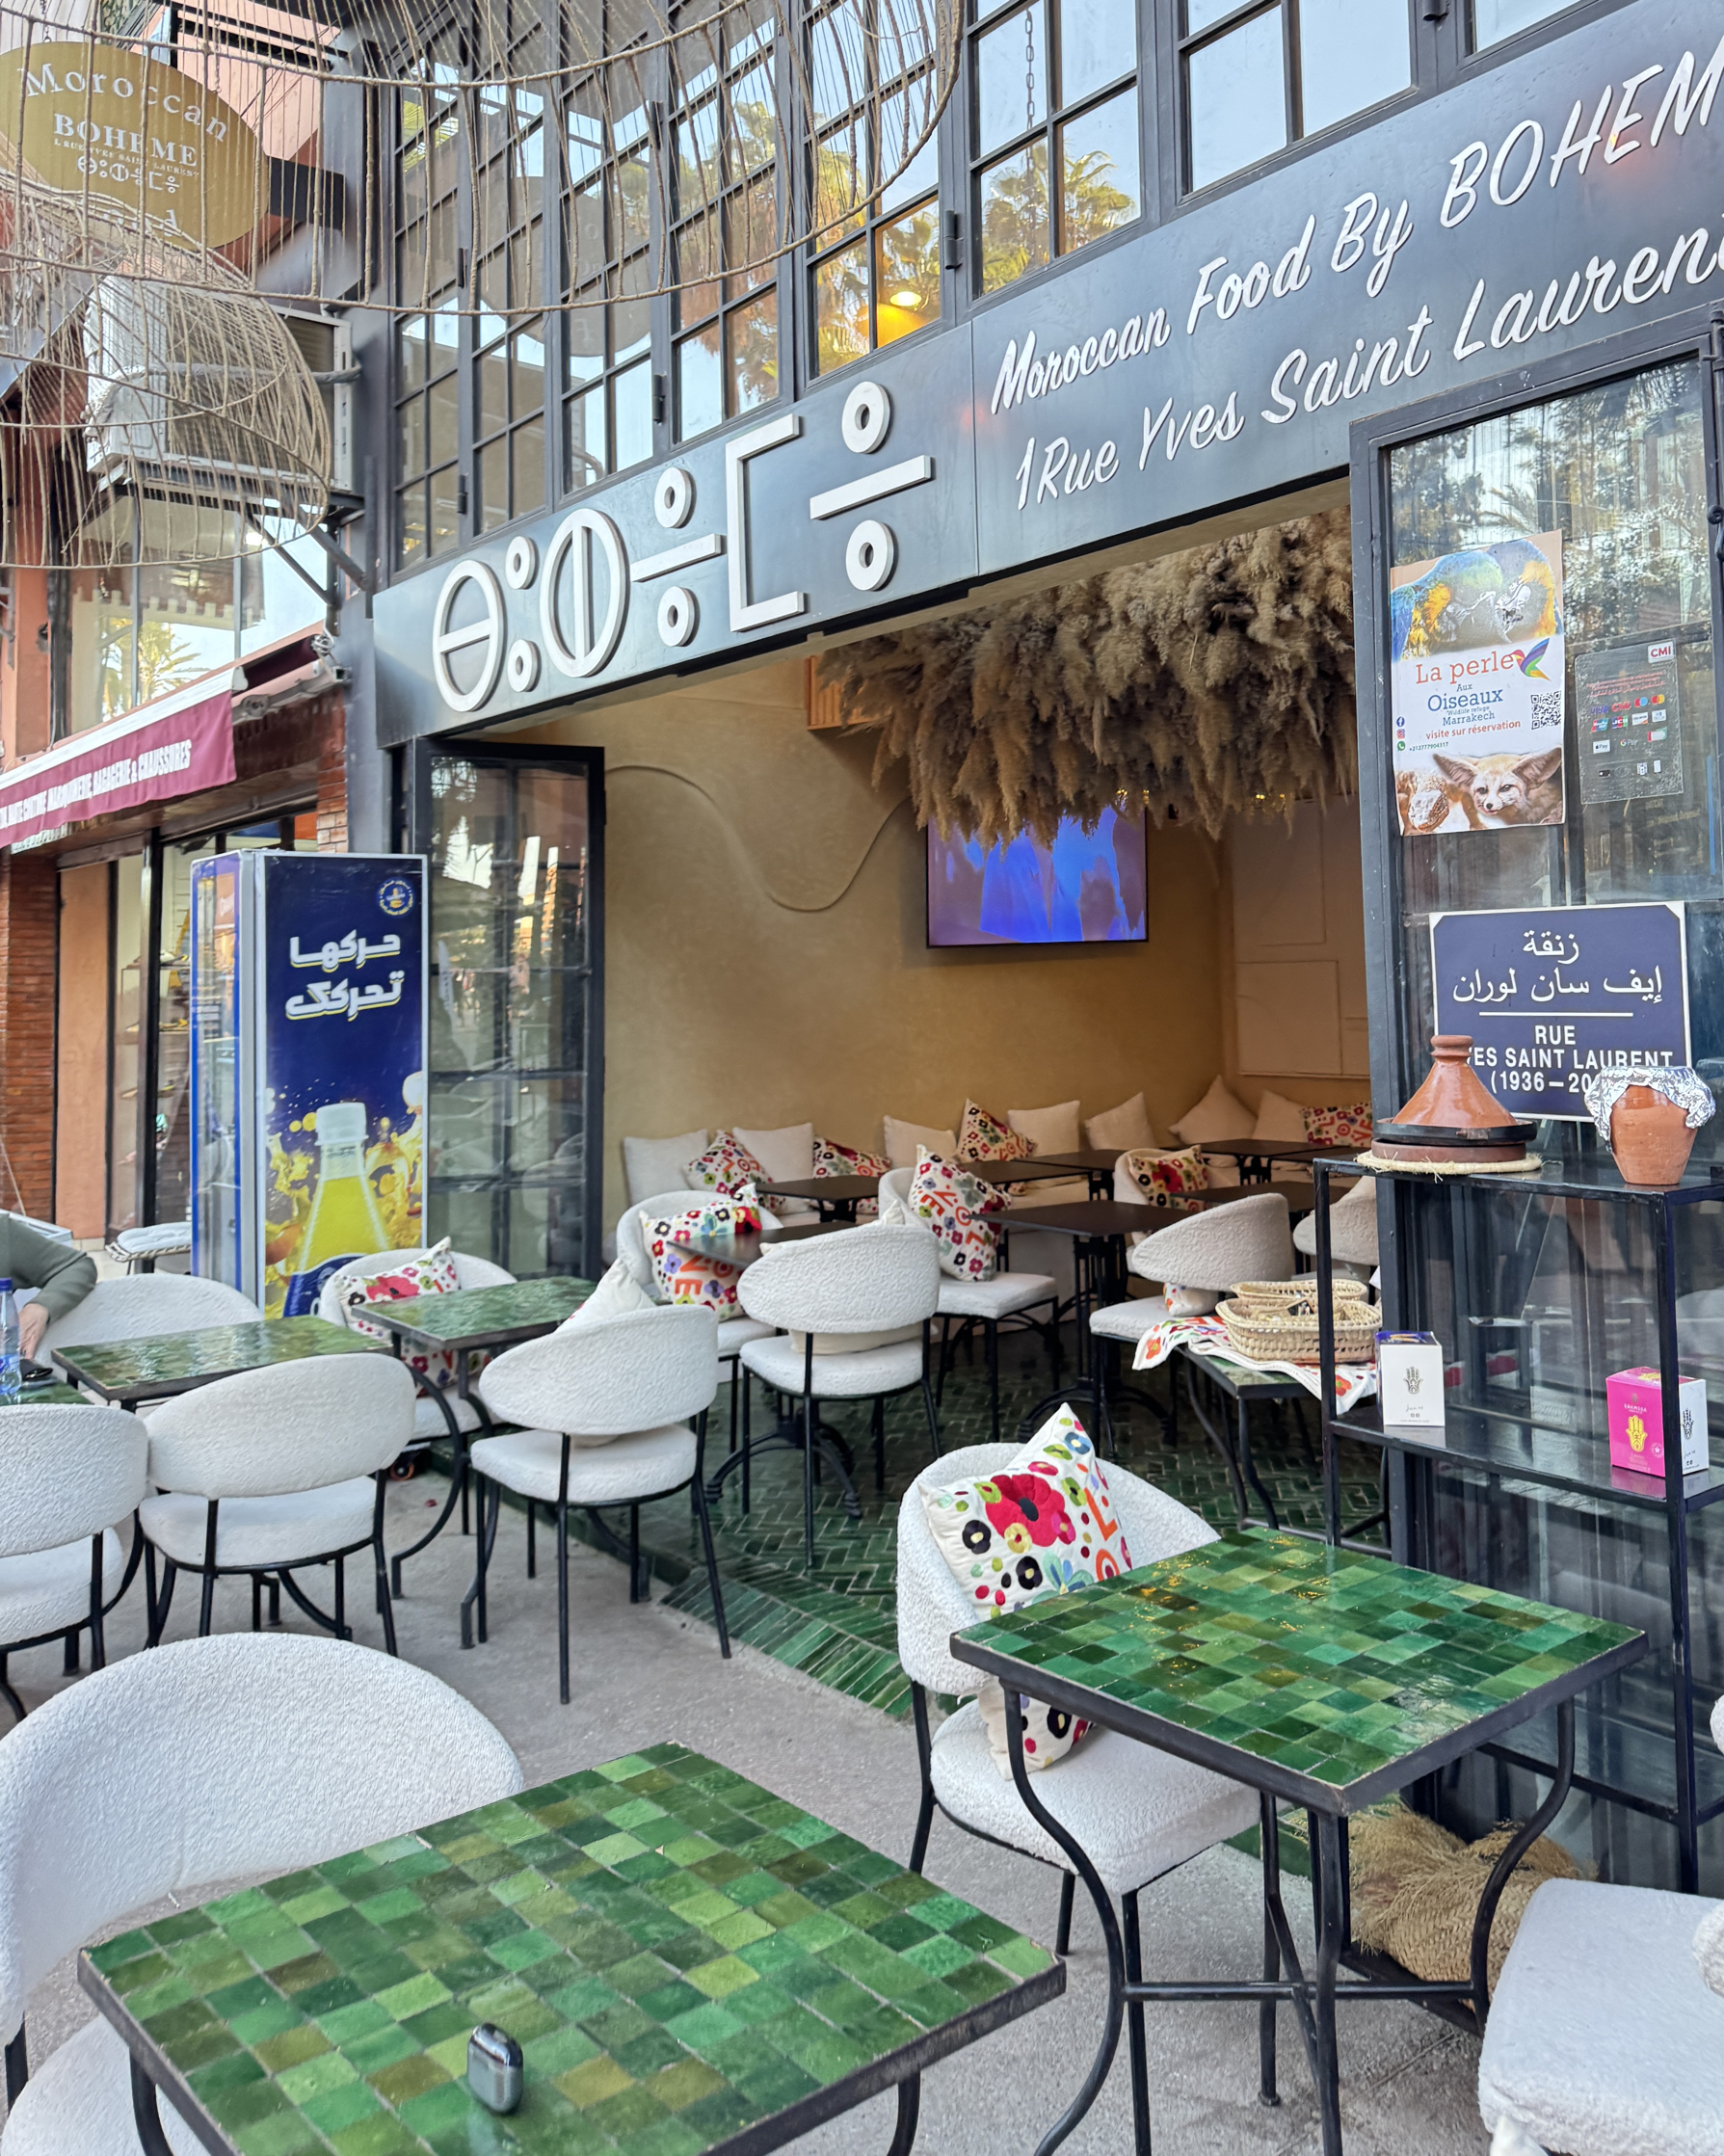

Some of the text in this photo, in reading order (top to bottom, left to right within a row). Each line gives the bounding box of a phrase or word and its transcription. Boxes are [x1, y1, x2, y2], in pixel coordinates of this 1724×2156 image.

[991, 304, 1171, 416] Moroccan
[1187, 214, 1315, 336] Food
[1331, 191, 1414, 298] By
[1138, 389, 1246, 472] Yves
[1261, 304, 1433, 425] Saint
[1453, 213, 1724, 361] Lauren
[1650, 645, 1671, 658] CMI
[1416, 651, 1515, 685] La perle
[1427, 689, 1503, 712] Oiseaux
[1456, 683, 1473, 692] Aux
[1426, 720, 1522, 740] visite sur réservation
[1443, 711, 1496, 727] Marrakech
[289, 928, 401, 972] حركها
[1523, 929, 1579, 964] زنقة
[285, 970, 405, 1022] تحركك
[1452, 965, 1663, 1004] إيف سان لوران
[1534, 1025, 1577, 1046] RUE
[1505, 1048, 1564, 1069] SAINT
[1573, 1049, 1674, 1070] LAURENT
